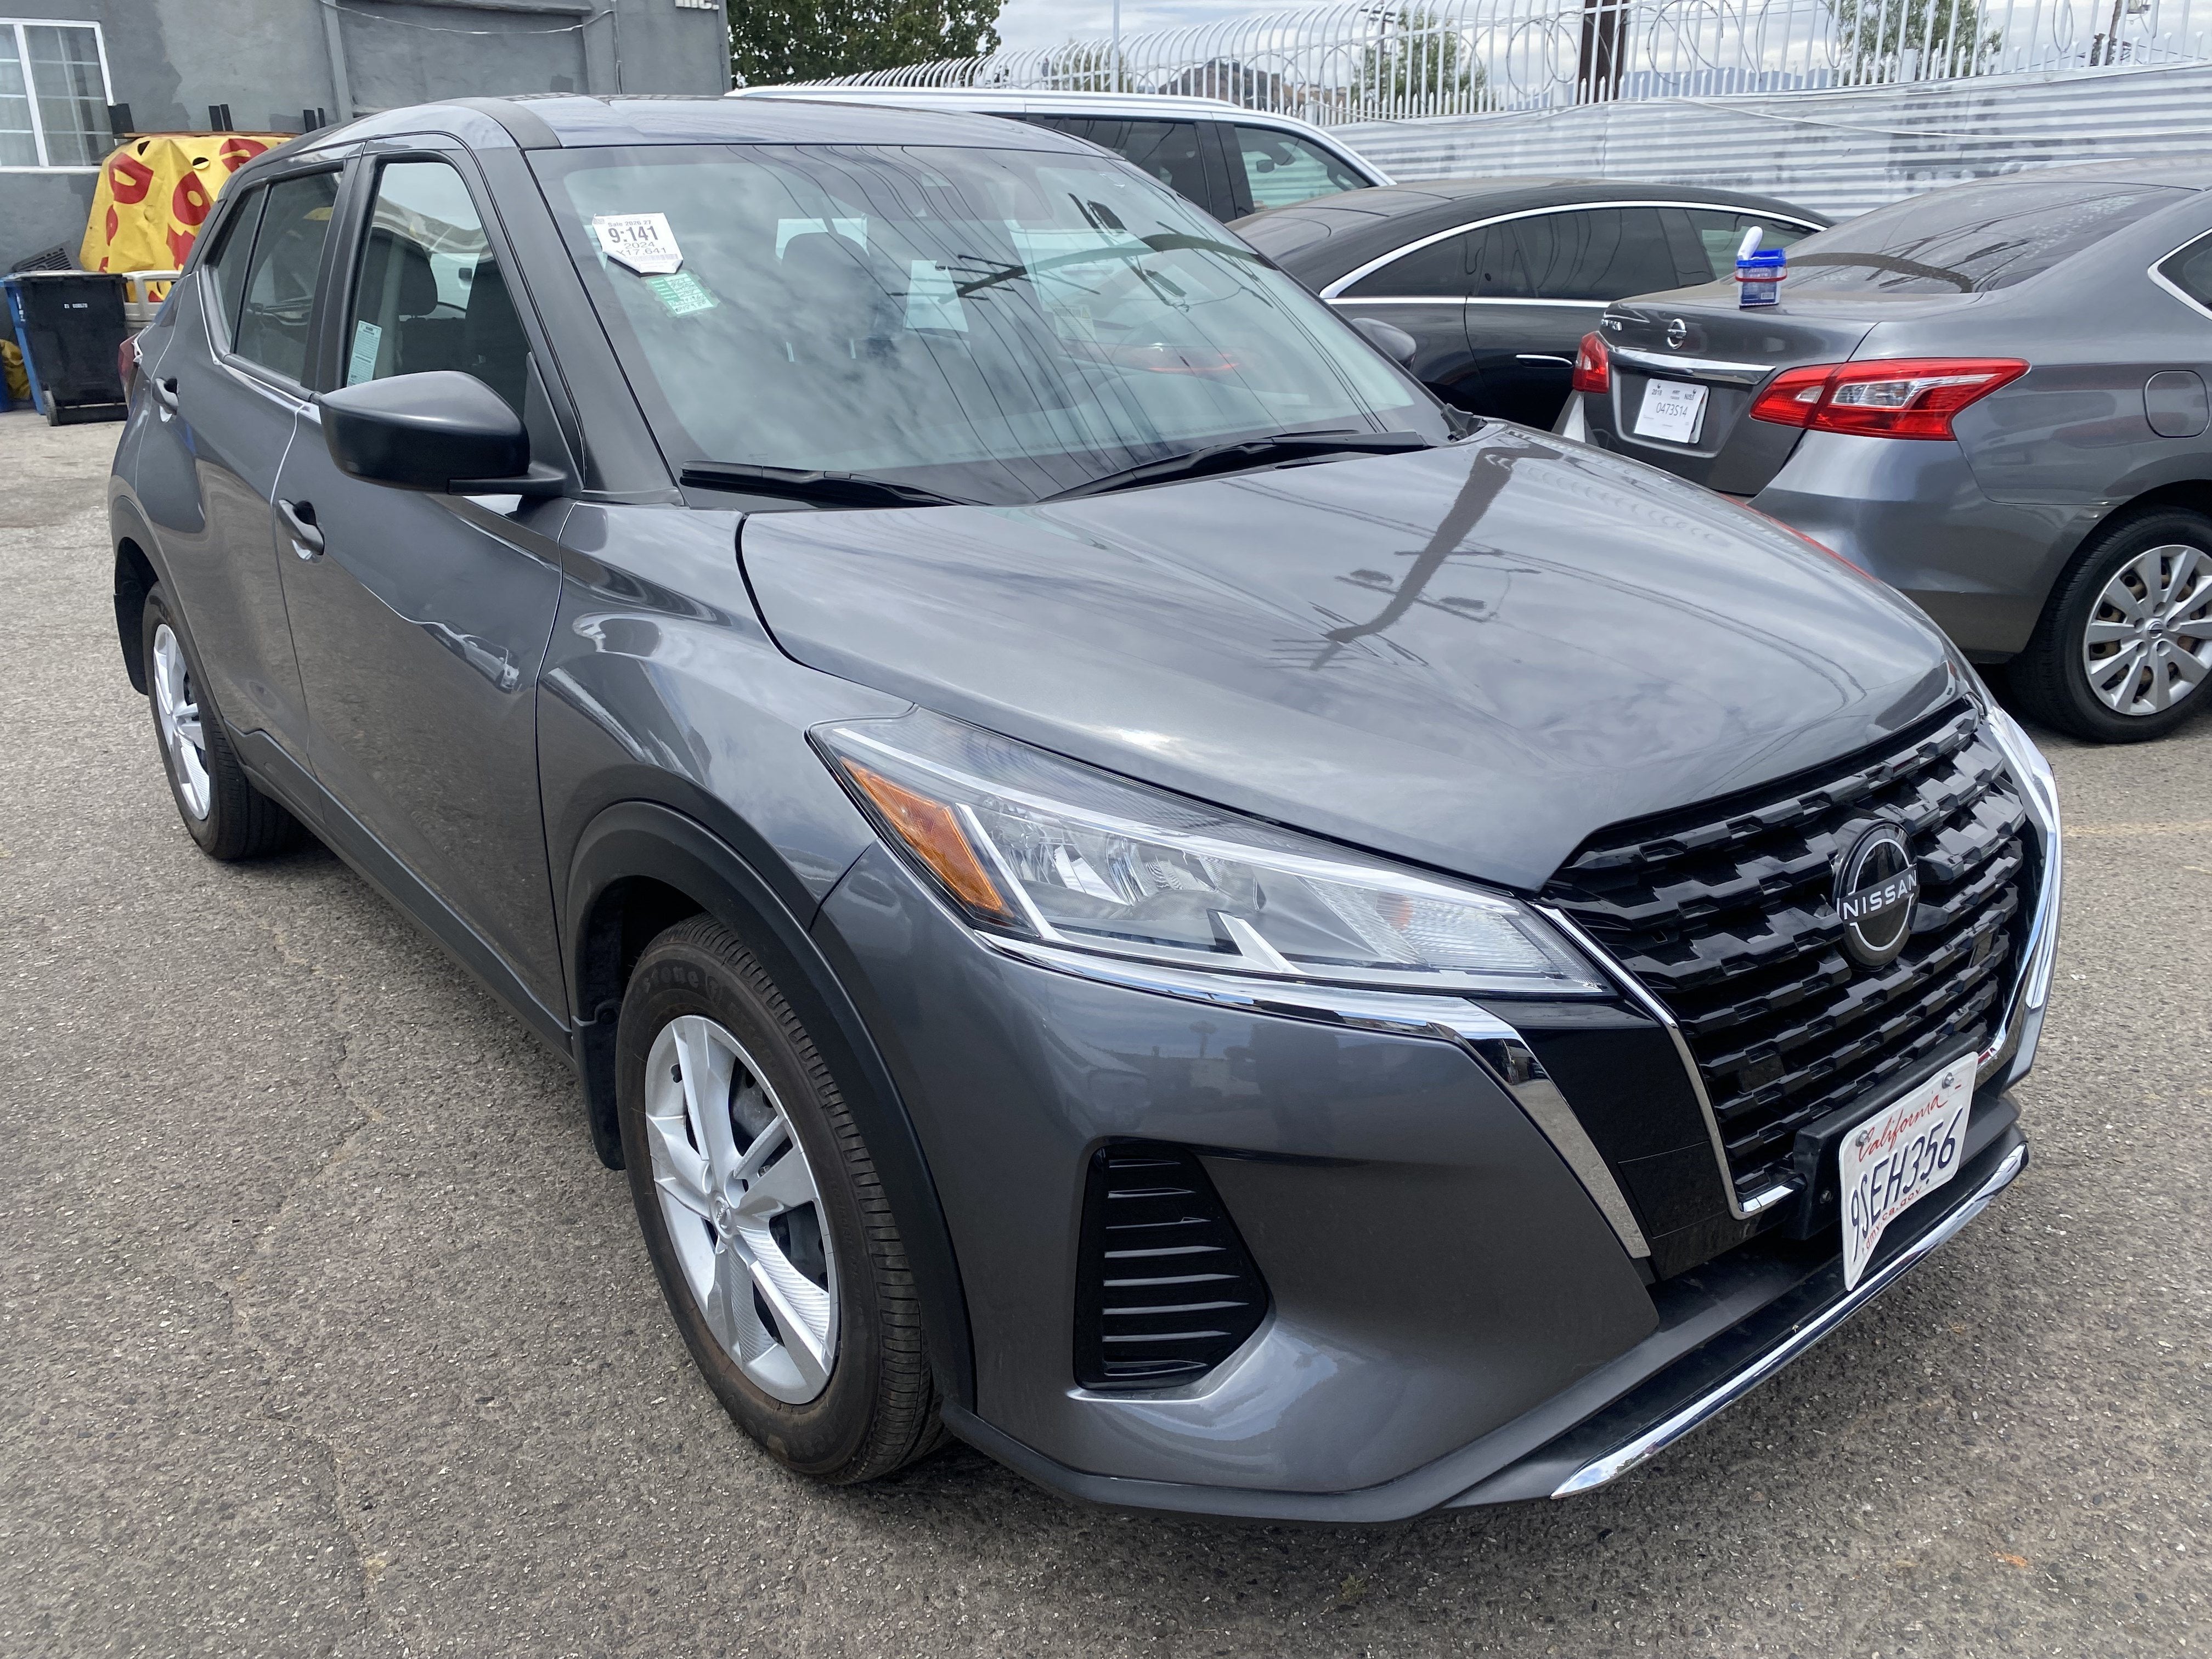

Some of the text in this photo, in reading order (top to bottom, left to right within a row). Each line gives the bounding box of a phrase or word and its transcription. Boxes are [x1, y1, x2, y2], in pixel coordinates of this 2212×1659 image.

[608, 225, 658, 243] 9:141
[1656, 402, 1688, 417] 0473S14
[1843, 870, 1917, 920] NISSAN
[1859, 1091, 1948, 1163] California
[1851, 1107, 1963, 1262] 9SEH356
[1866, 1186, 1922, 1250] dmv.ca.gov
